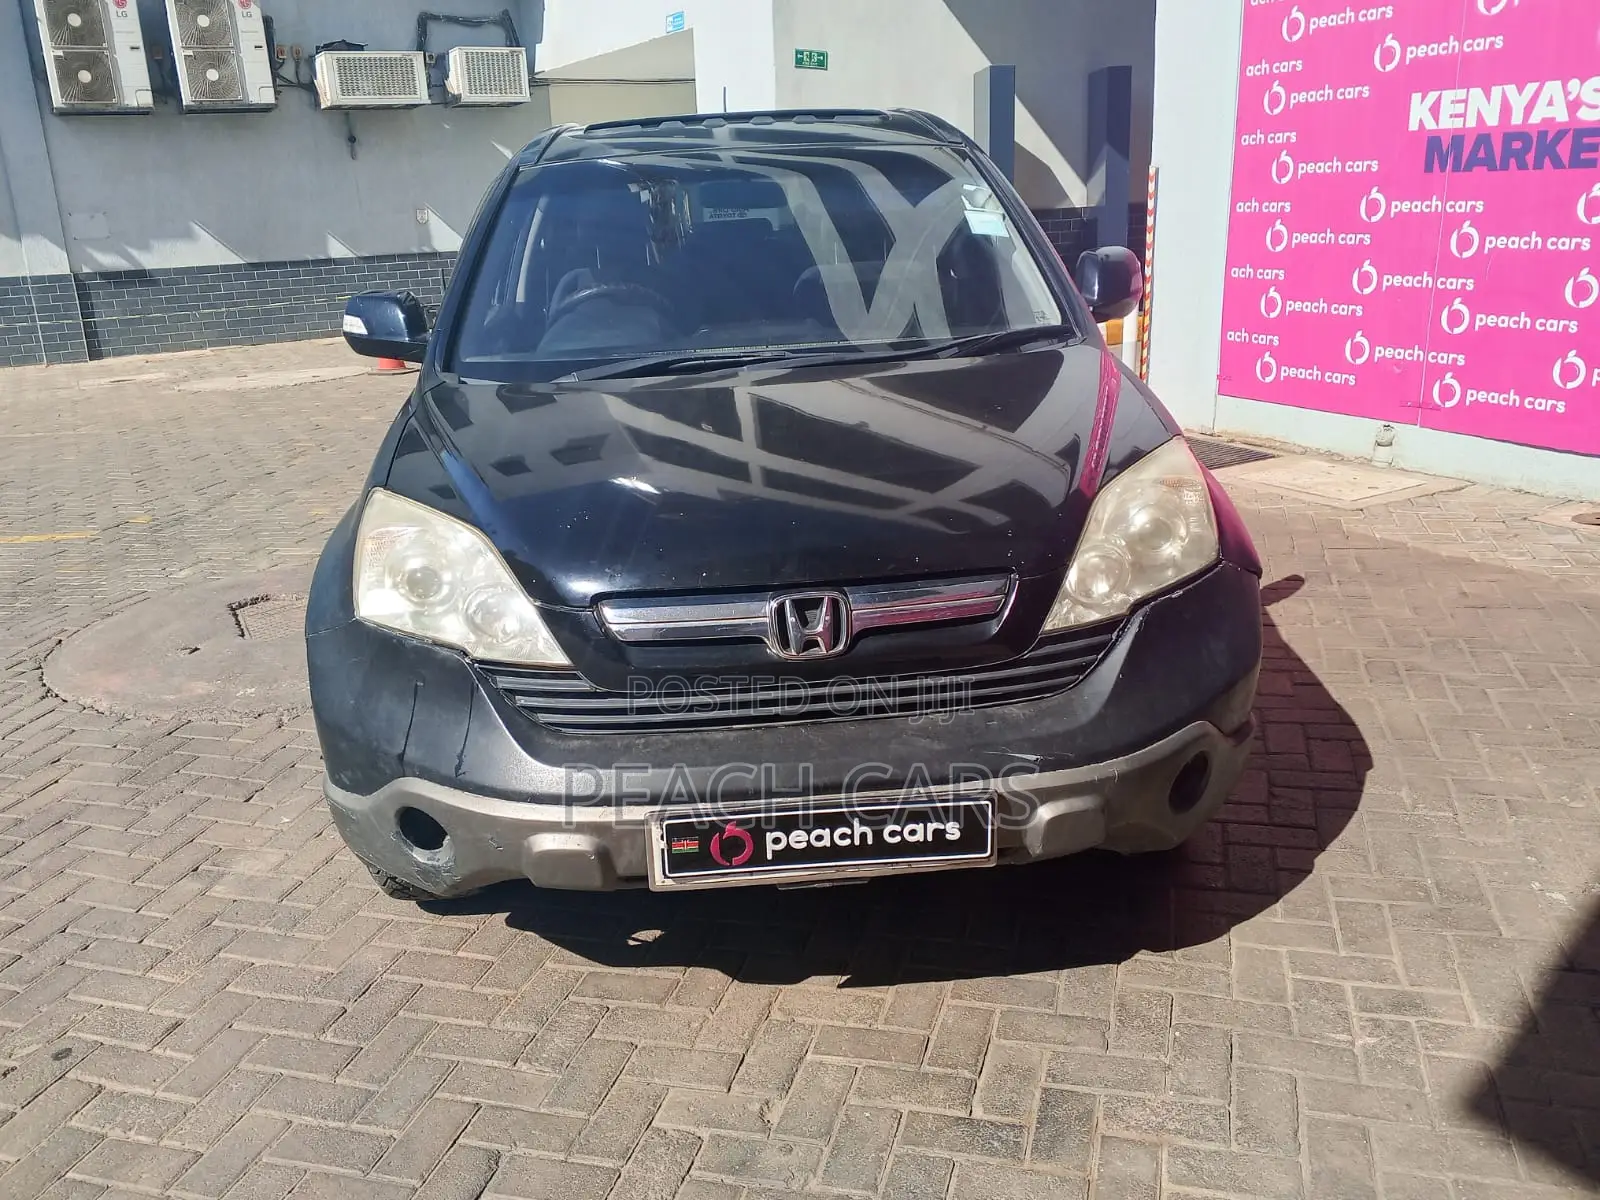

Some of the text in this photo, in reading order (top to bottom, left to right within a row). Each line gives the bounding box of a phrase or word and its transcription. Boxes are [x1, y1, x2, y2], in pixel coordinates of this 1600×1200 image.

[1309, 6, 1394, 35] peach cars
[1406, 35, 1504, 64] peach cars
[1246, 59, 1303, 76] ach cars
[1290, 84, 1370, 109] peach cars
[1408, 76, 1600, 131] KENYA'S
[1241, 130, 1297, 146] ach cars
[1298, 156, 1378, 179] peach cars
[1236, 197, 1291, 213] ach cars
[1390, 195, 1484, 218] peach cars
[1292, 228, 1371, 248] peach cars
[1484, 231, 1591, 254] peach cars
[1231, 264, 1285, 281] ach cars
[1382, 271, 1474, 291] peach cars
[1286, 298, 1363, 317] peach cars
[1475, 312, 1579, 334] peach cars
[1227, 328, 1280, 347] ach cars
[1374, 344, 1466, 366] peach cars
[1281, 364, 1356, 386] peach cars
[1466, 388, 1566, 414] peach cars
[765, 818, 961, 860] peach cars
